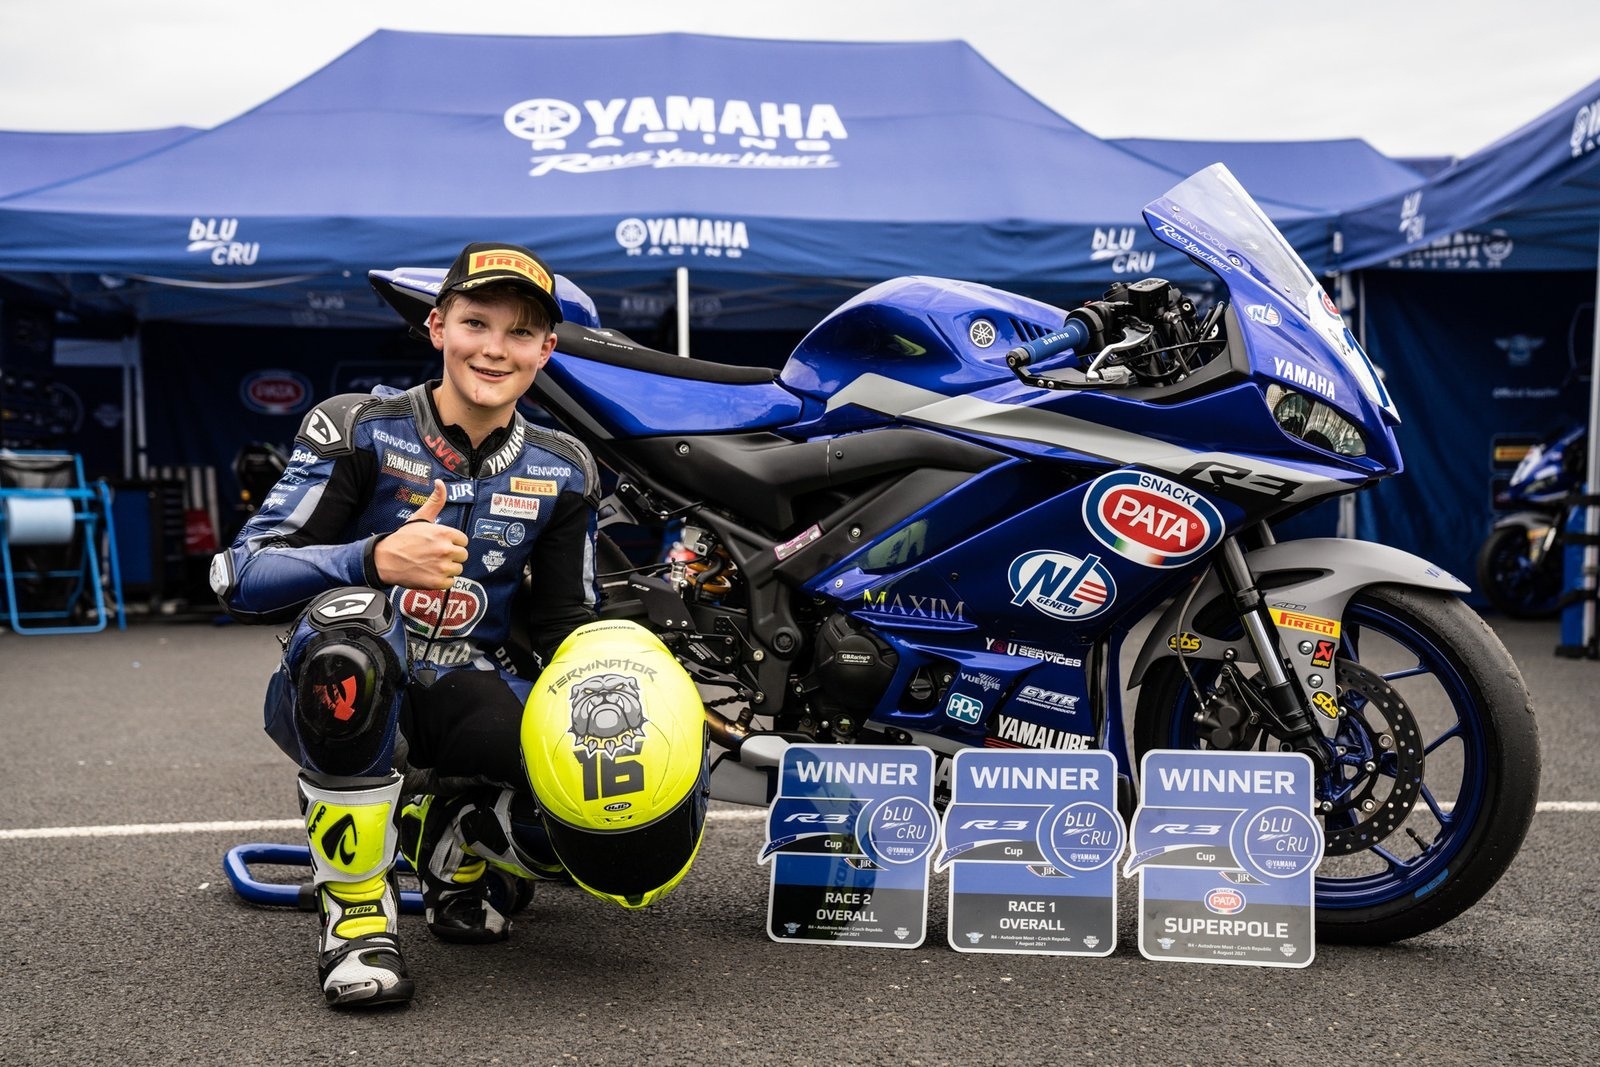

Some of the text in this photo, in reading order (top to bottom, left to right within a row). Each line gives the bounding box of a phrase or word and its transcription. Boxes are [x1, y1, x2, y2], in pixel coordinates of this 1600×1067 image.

[582, 96, 848, 139] YAMAHA
[532, 131, 831, 151] RACING
[646, 218, 749, 249] YAMAHA
[1156, 221, 1189, 246] Revs
[1184, 242, 1210, 261] Your
[1172, 212, 1227, 252] KENWOOD
[626, 245, 742, 258] RACING
[1041, 332, 1070, 346] domino
[1273, 356, 1336, 401] YAMAHA
[373, 429, 421, 455] KENWOOD
[487, 425, 525, 476] YAMAHA
[424, 434, 462, 472] JVC
[386, 453, 431, 479] YAMALUBE
[527, 464, 571, 477] KENWOOD
[515, 480, 553, 493] PIRELLI
[1140, 476, 1196, 506] SNACK
[504, 496, 538, 511] YAMAHA
[1111, 494, 1190, 548] PATA
[1011, 554, 1101, 607] NL
[411, 592, 467, 620] PATA
[863, 588, 965, 622] MAXIM
[1036, 596, 1078, 615] GENEVA
[1280, 611, 1335, 635] PIRELLI
[1019, 649, 1082, 667] SERVICES
[1020, 645, 1065, 658] YAMAHA MOTOR
[961, 673, 1000, 690] VUEMME
[1020, 685, 1080, 708] GYTR
[949, 698, 980, 720] PPG
[1050, 704, 1077, 716] PRODUCTS
[997, 714, 1092, 750] YAMALUBE
[573, 741, 645, 801] 16
[796, 761, 918, 786] WINNER
[970, 767, 1100, 790] WINNER
[1159, 768, 1296, 795] WINNER
[784, 813, 850, 824] R3
[960, 820, 1030, 830] R3
[1150, 824, 1223, 835] R3
[824, 840, 842, 849] Cup
[1004, 847, 1023, 857] Cup
[1196, 852, 1216, 862] Cup
[1272, 860, 1297, 868] YAMAHA
[825, 892, 871, 904] RACE 2
[1008, 901, 1056, 913] RACE 1
[1213, 896, 1236, 906] PATA
[349, 906, 374, 914] FLOW
[816, 909, 878, 922] OVERALL
[1000, 918, 1065, 931] OVERALL
[1164, 917, 1289, 938] SUPERPOLE
